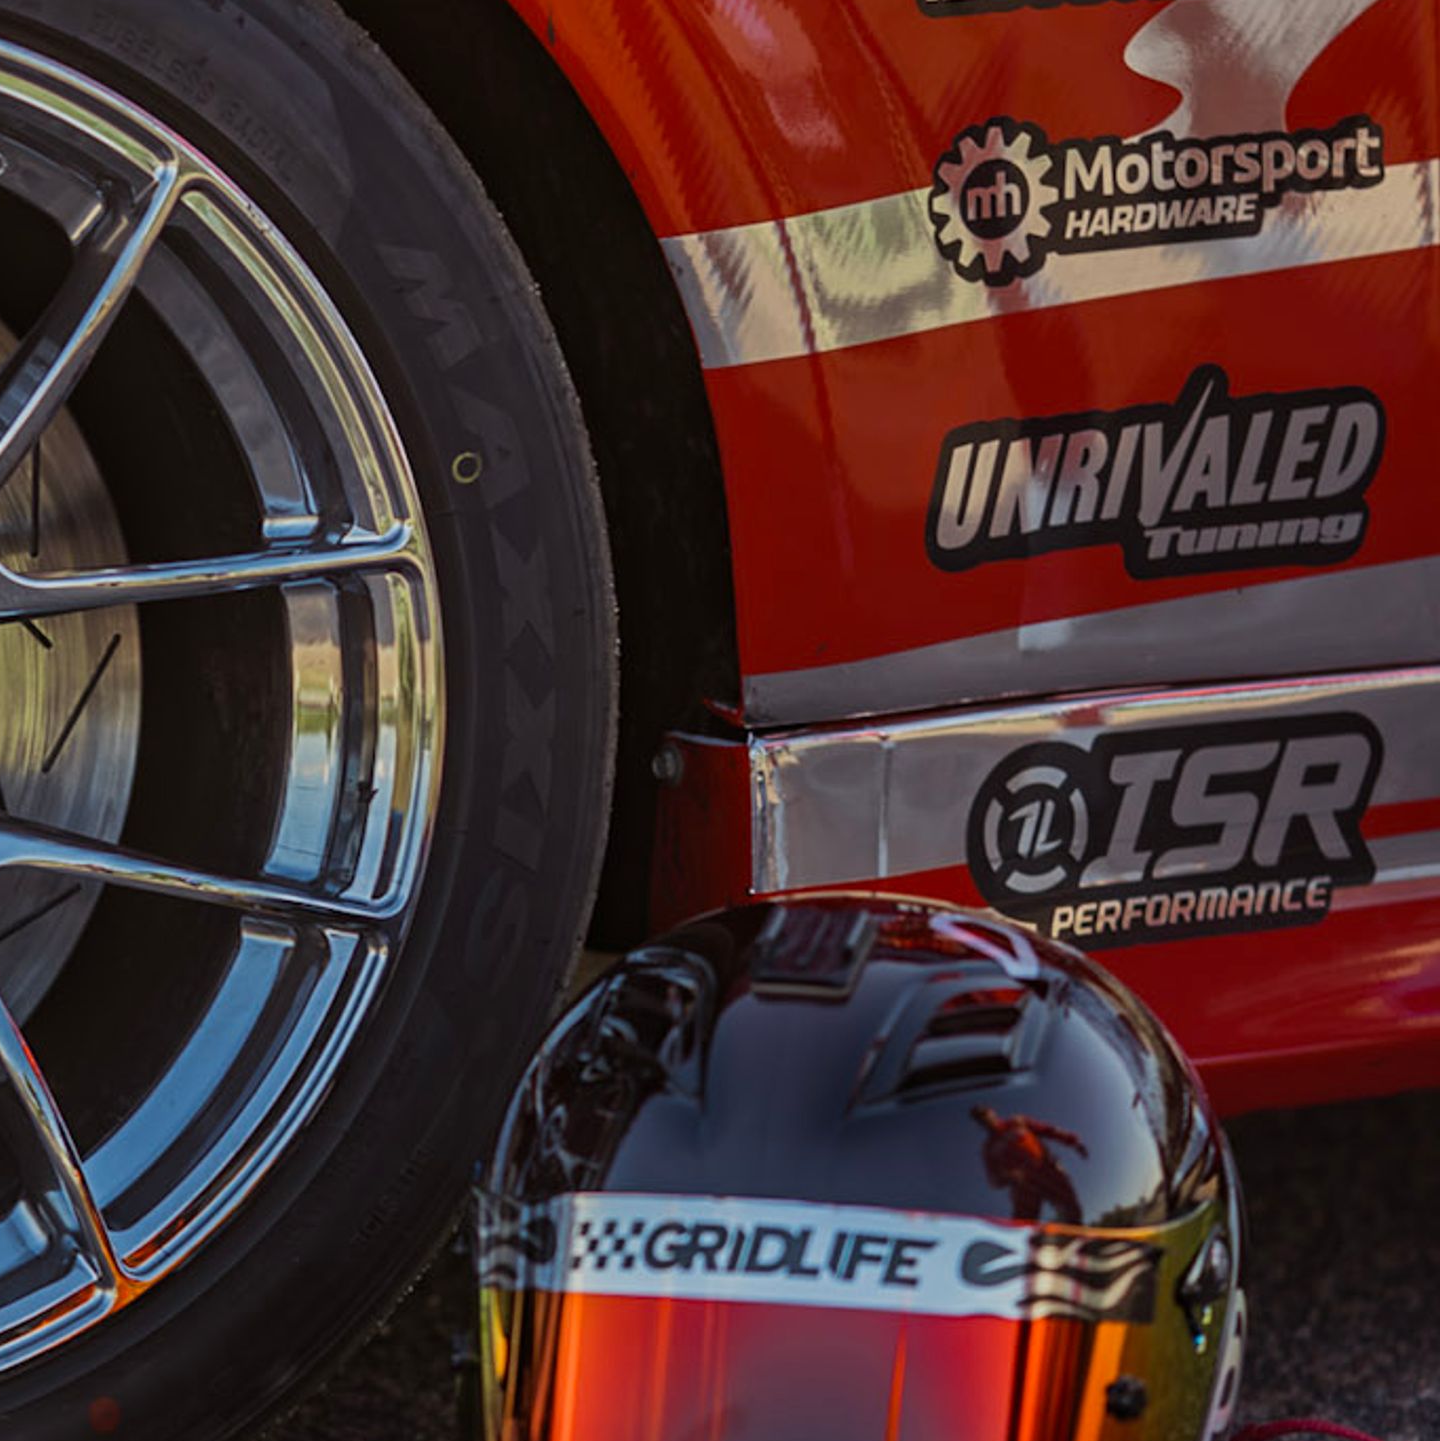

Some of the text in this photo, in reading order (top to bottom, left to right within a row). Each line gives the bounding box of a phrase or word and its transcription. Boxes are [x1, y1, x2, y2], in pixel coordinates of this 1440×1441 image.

[1063, 127, 1382, 201] Motorsport
[1063, 192, 1258, 240] HARDWARE
[936, 378, 1379, 551] UNRIVALED
[374, 242, 557, 978] MAXXIS
[1078, 732, 1372, 889] ISR
[1051, 875, 1332, 940] PERFORMANCE
[643, 1219, 942, 1289] GRIDLIFE
